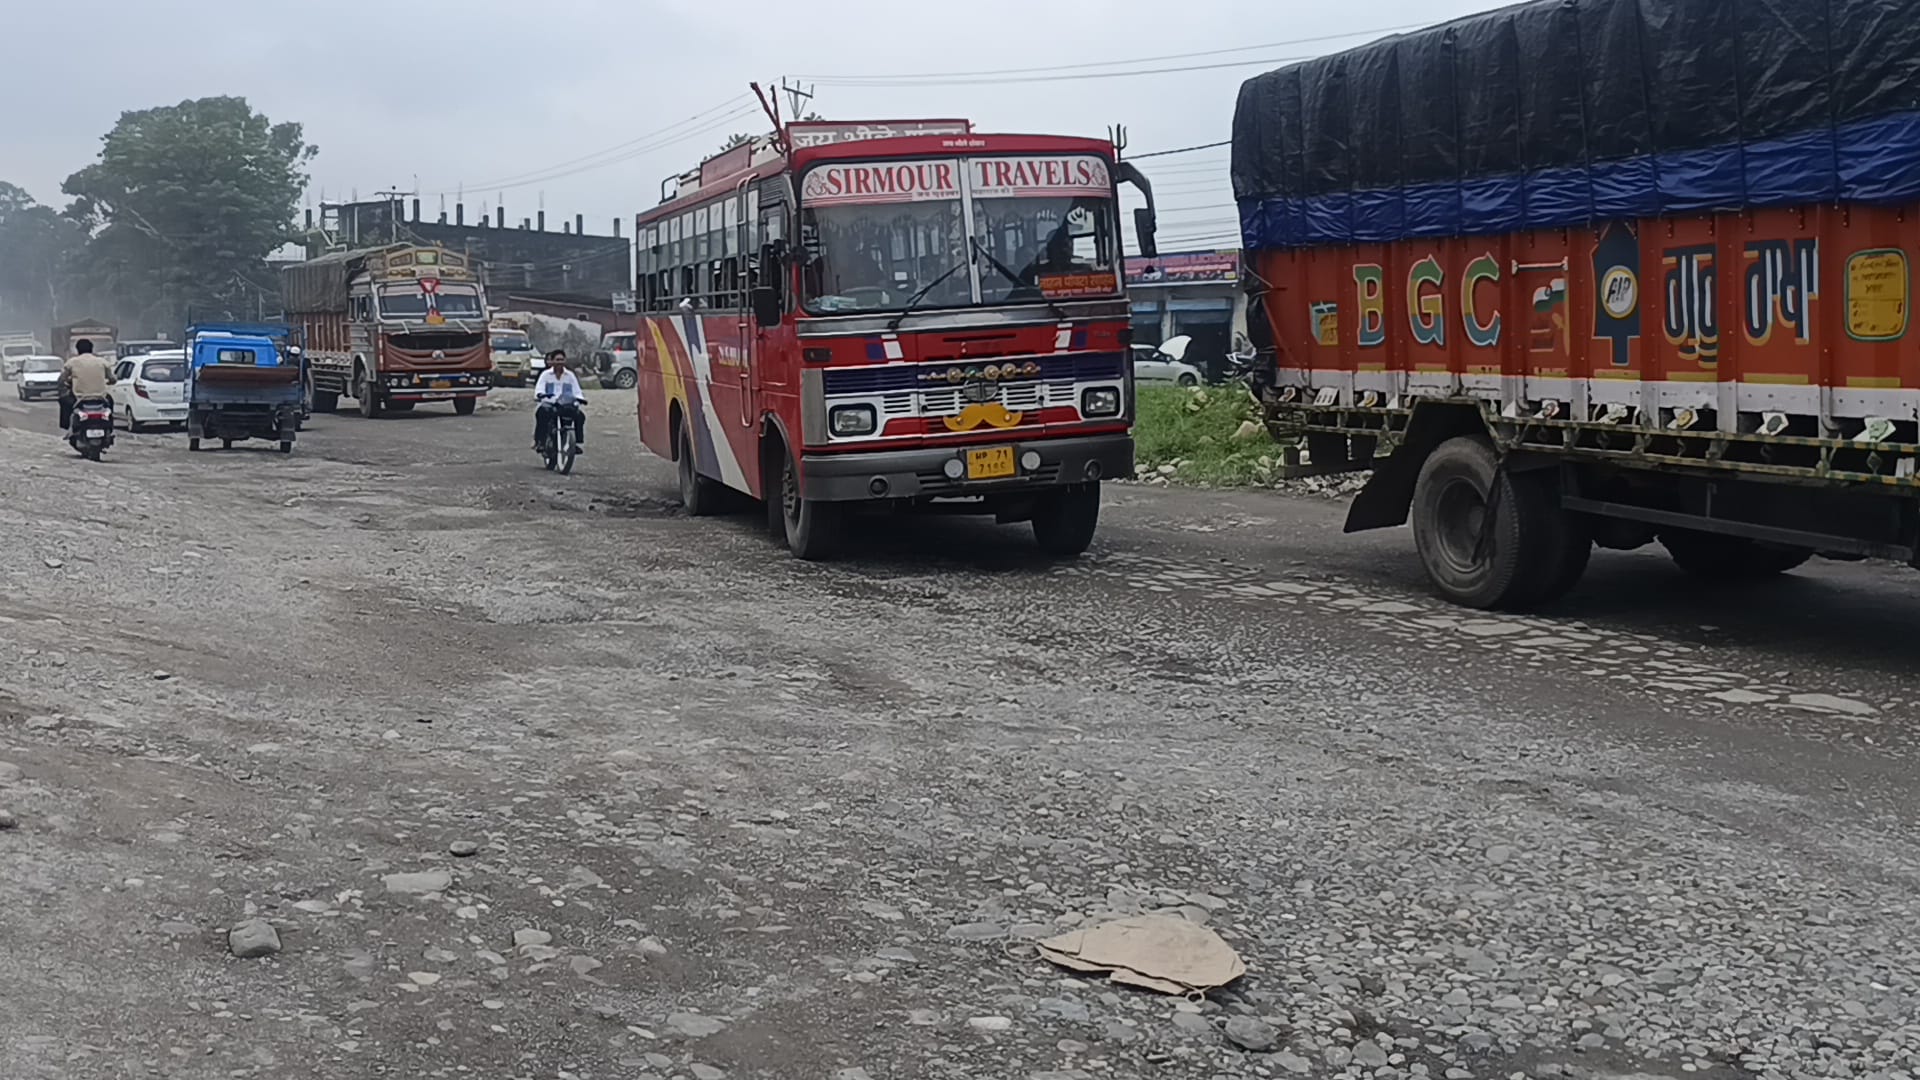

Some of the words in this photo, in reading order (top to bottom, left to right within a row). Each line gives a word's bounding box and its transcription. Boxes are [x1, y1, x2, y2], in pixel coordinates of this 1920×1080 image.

[793, 131, 837, 147] जय
[826, 163, 953, 196] SIRMOUR
[976, 159, 1092, 188] TRAVELS
[1353, 251, 1500, 346] BGC
[980, 462, 1005, 474] 71
